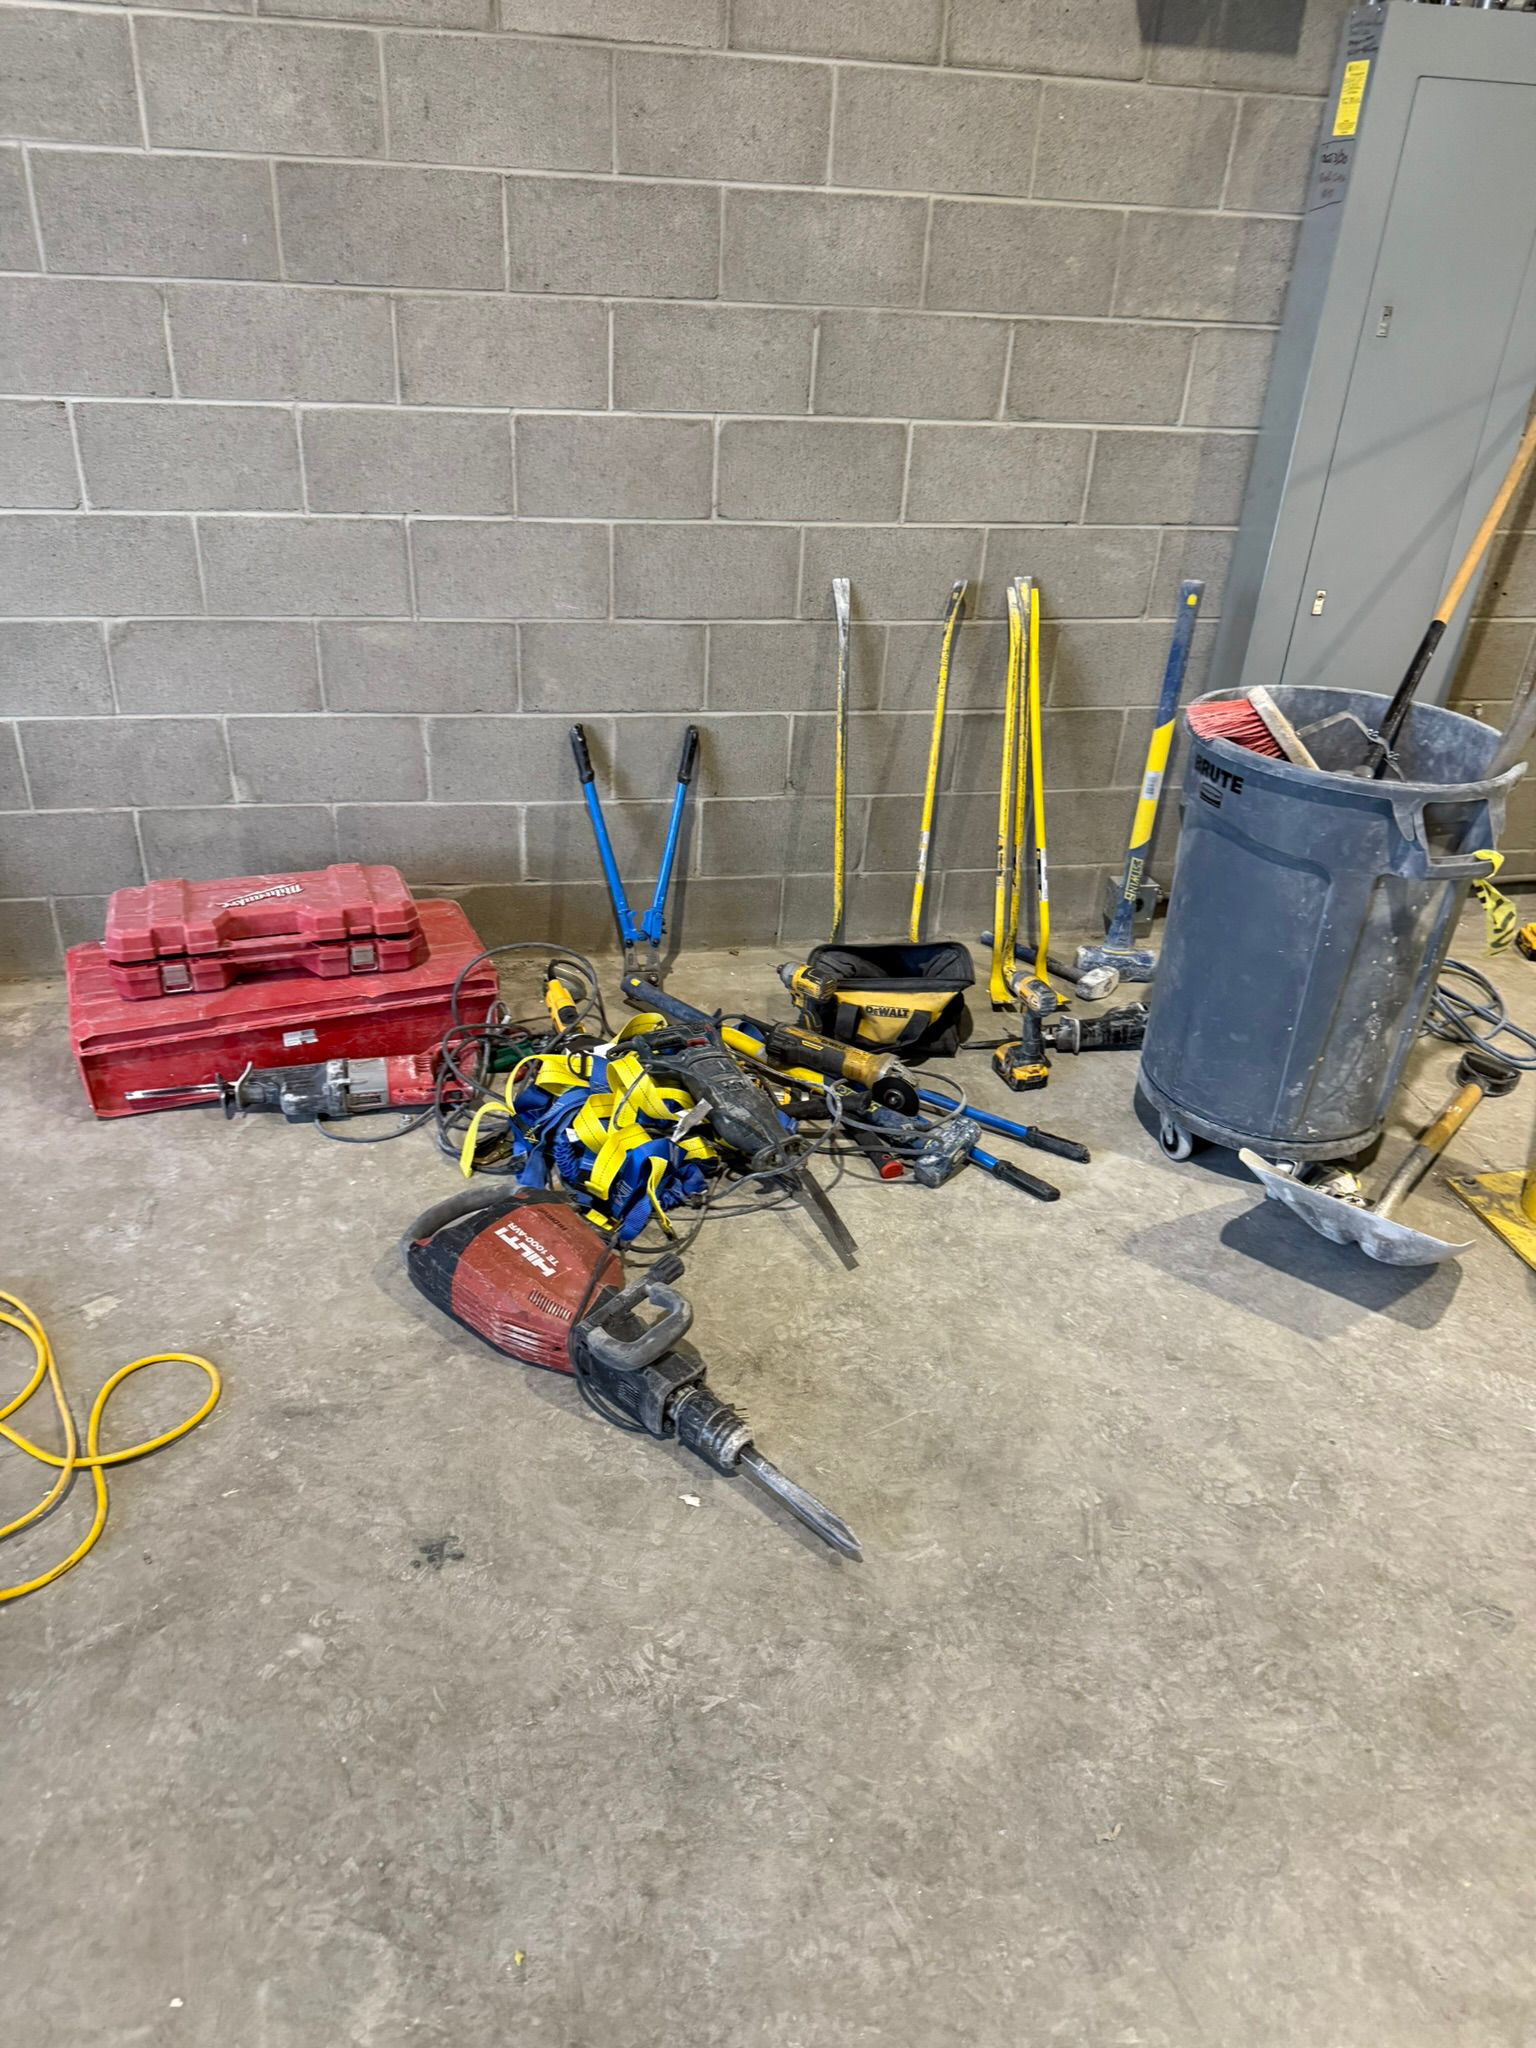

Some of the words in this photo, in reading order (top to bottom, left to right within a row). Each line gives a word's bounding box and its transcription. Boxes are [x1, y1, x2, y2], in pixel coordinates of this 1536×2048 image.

[1194, 754, 1245, 795] BRUTE
[218, 883, 305, 908] Milwaukee
[1124, 857, 1144, 901] ESTWING
[494, 1226, 557, 1278] HILTI
[507, 1222, 549, 1256] 1000-AVR
[546, 1254, 560, 1267] TE
